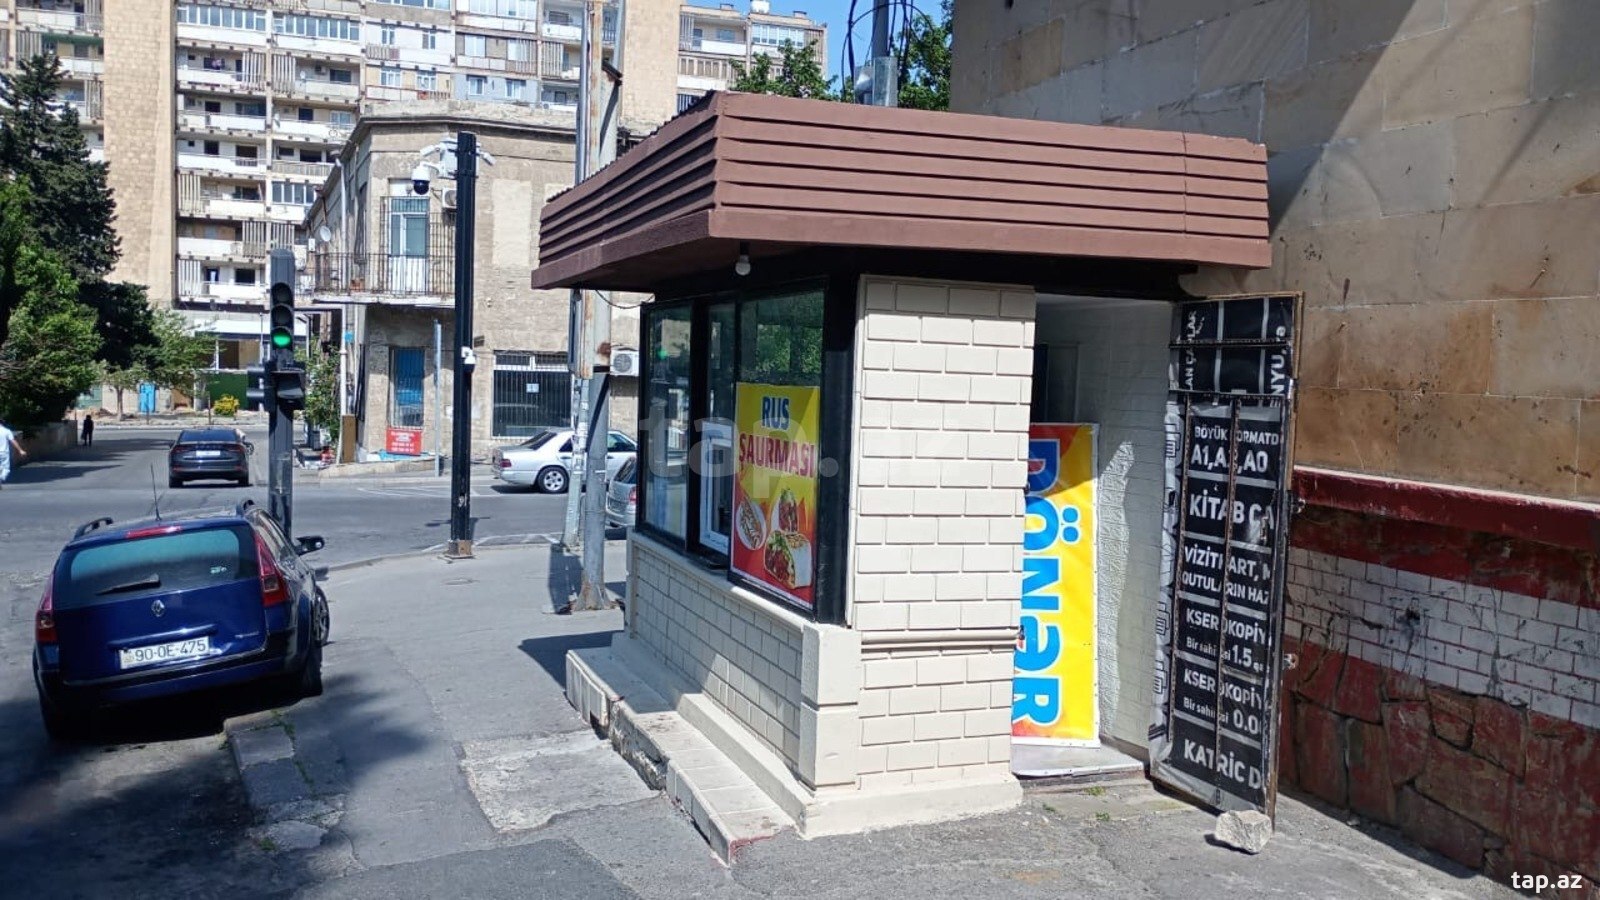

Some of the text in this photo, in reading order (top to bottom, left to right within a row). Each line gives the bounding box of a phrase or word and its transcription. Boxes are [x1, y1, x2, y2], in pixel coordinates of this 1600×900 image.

[762, 396, 790, 430] RUS
[1194, 424, 1279, 446] BÖYÜK ORMATD
[1189, 489, 1245, 524] KİTAB
[1186, 636, 1199, 651] Bir
[1232, 644, 1252, 667] 1.5
[1183, 696, 1195, 711] Bir
